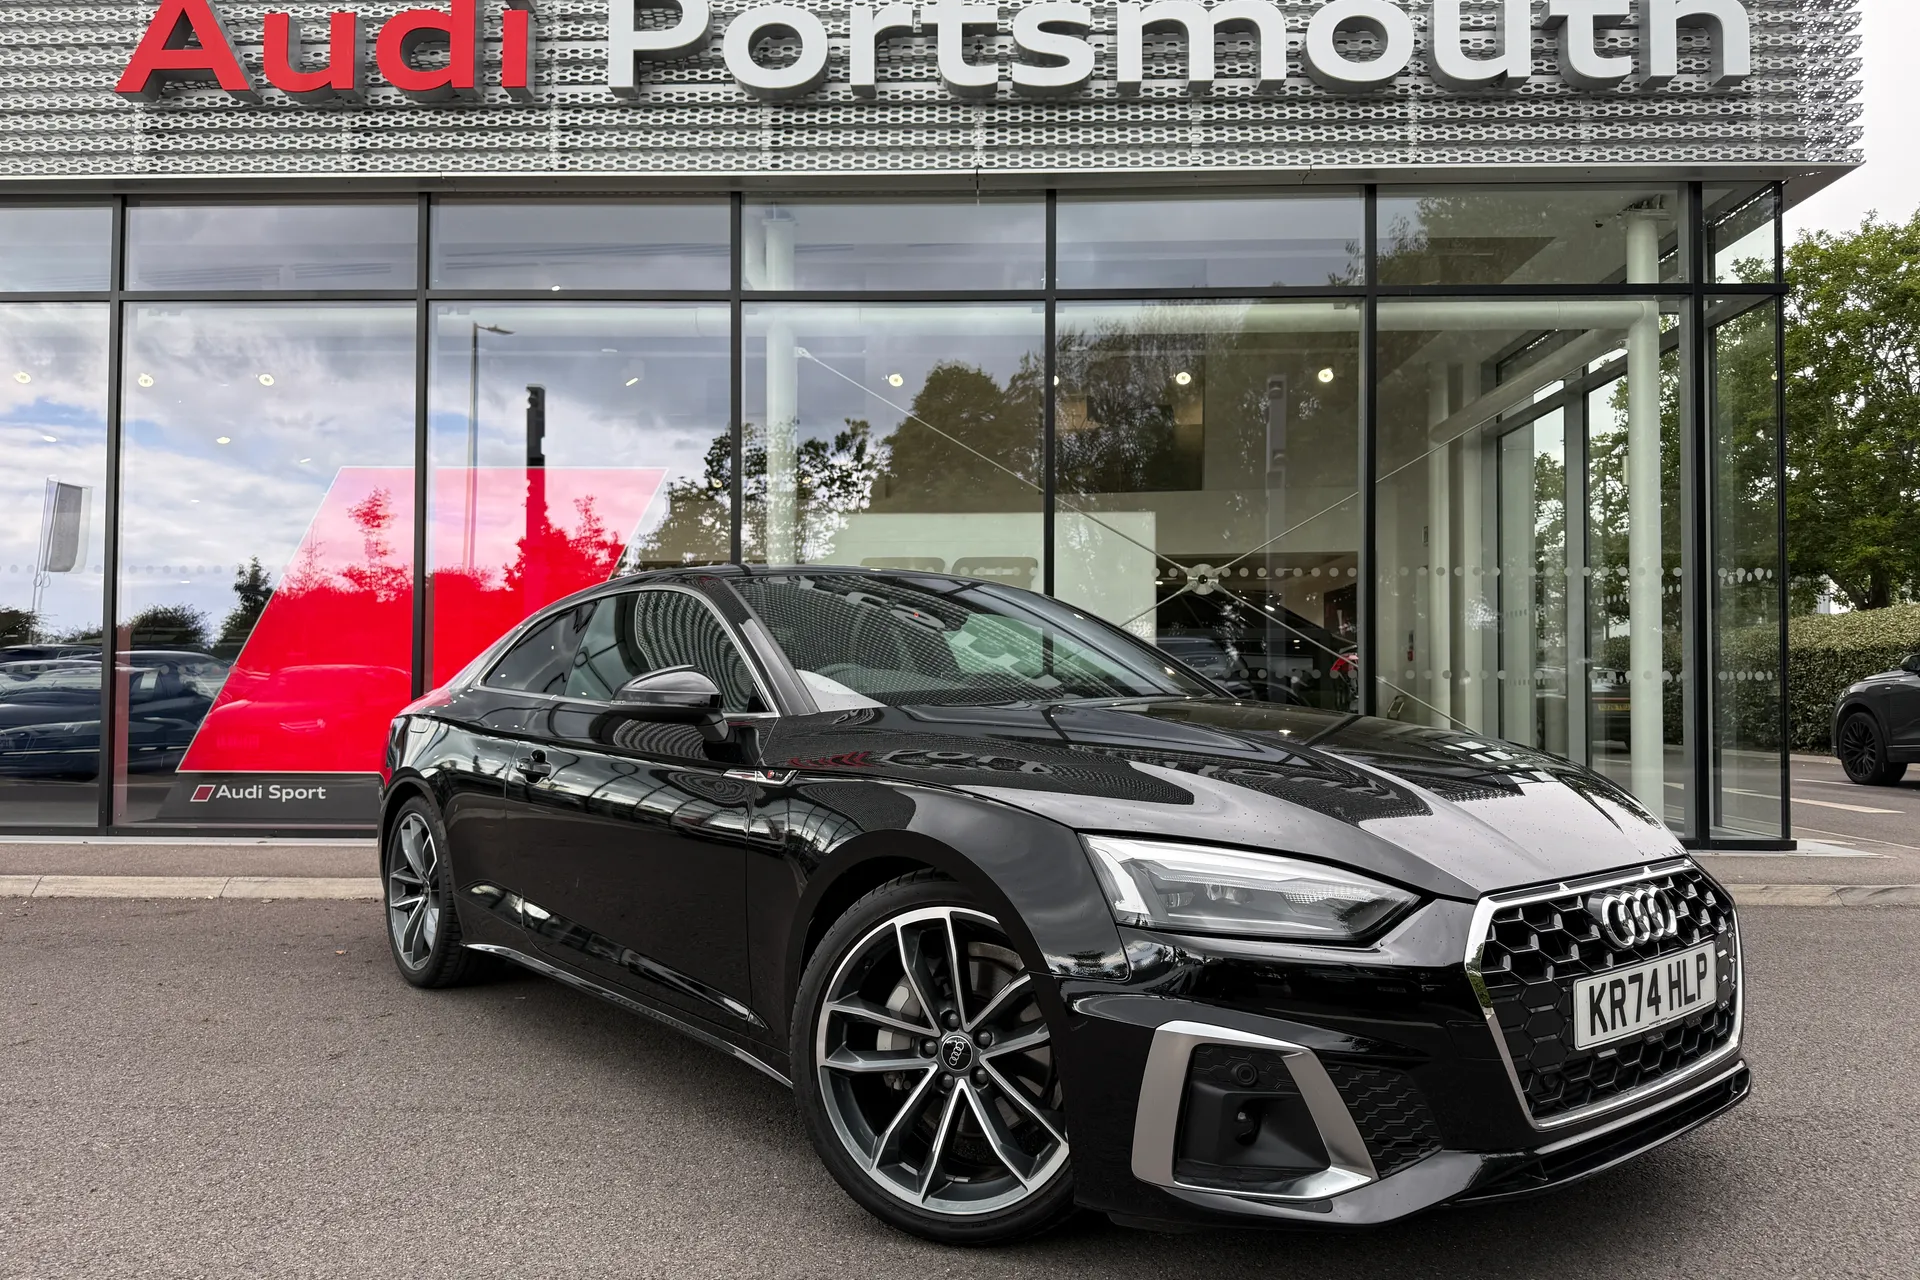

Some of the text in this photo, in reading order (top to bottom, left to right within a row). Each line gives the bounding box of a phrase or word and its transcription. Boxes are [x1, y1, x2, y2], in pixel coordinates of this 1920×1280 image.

[115, 0, 1750, 93] Audi Portsmouth
[216, 785, 326, 802] Audi Sport
[1588, 952, 1707, 1036] KR74 HLP
